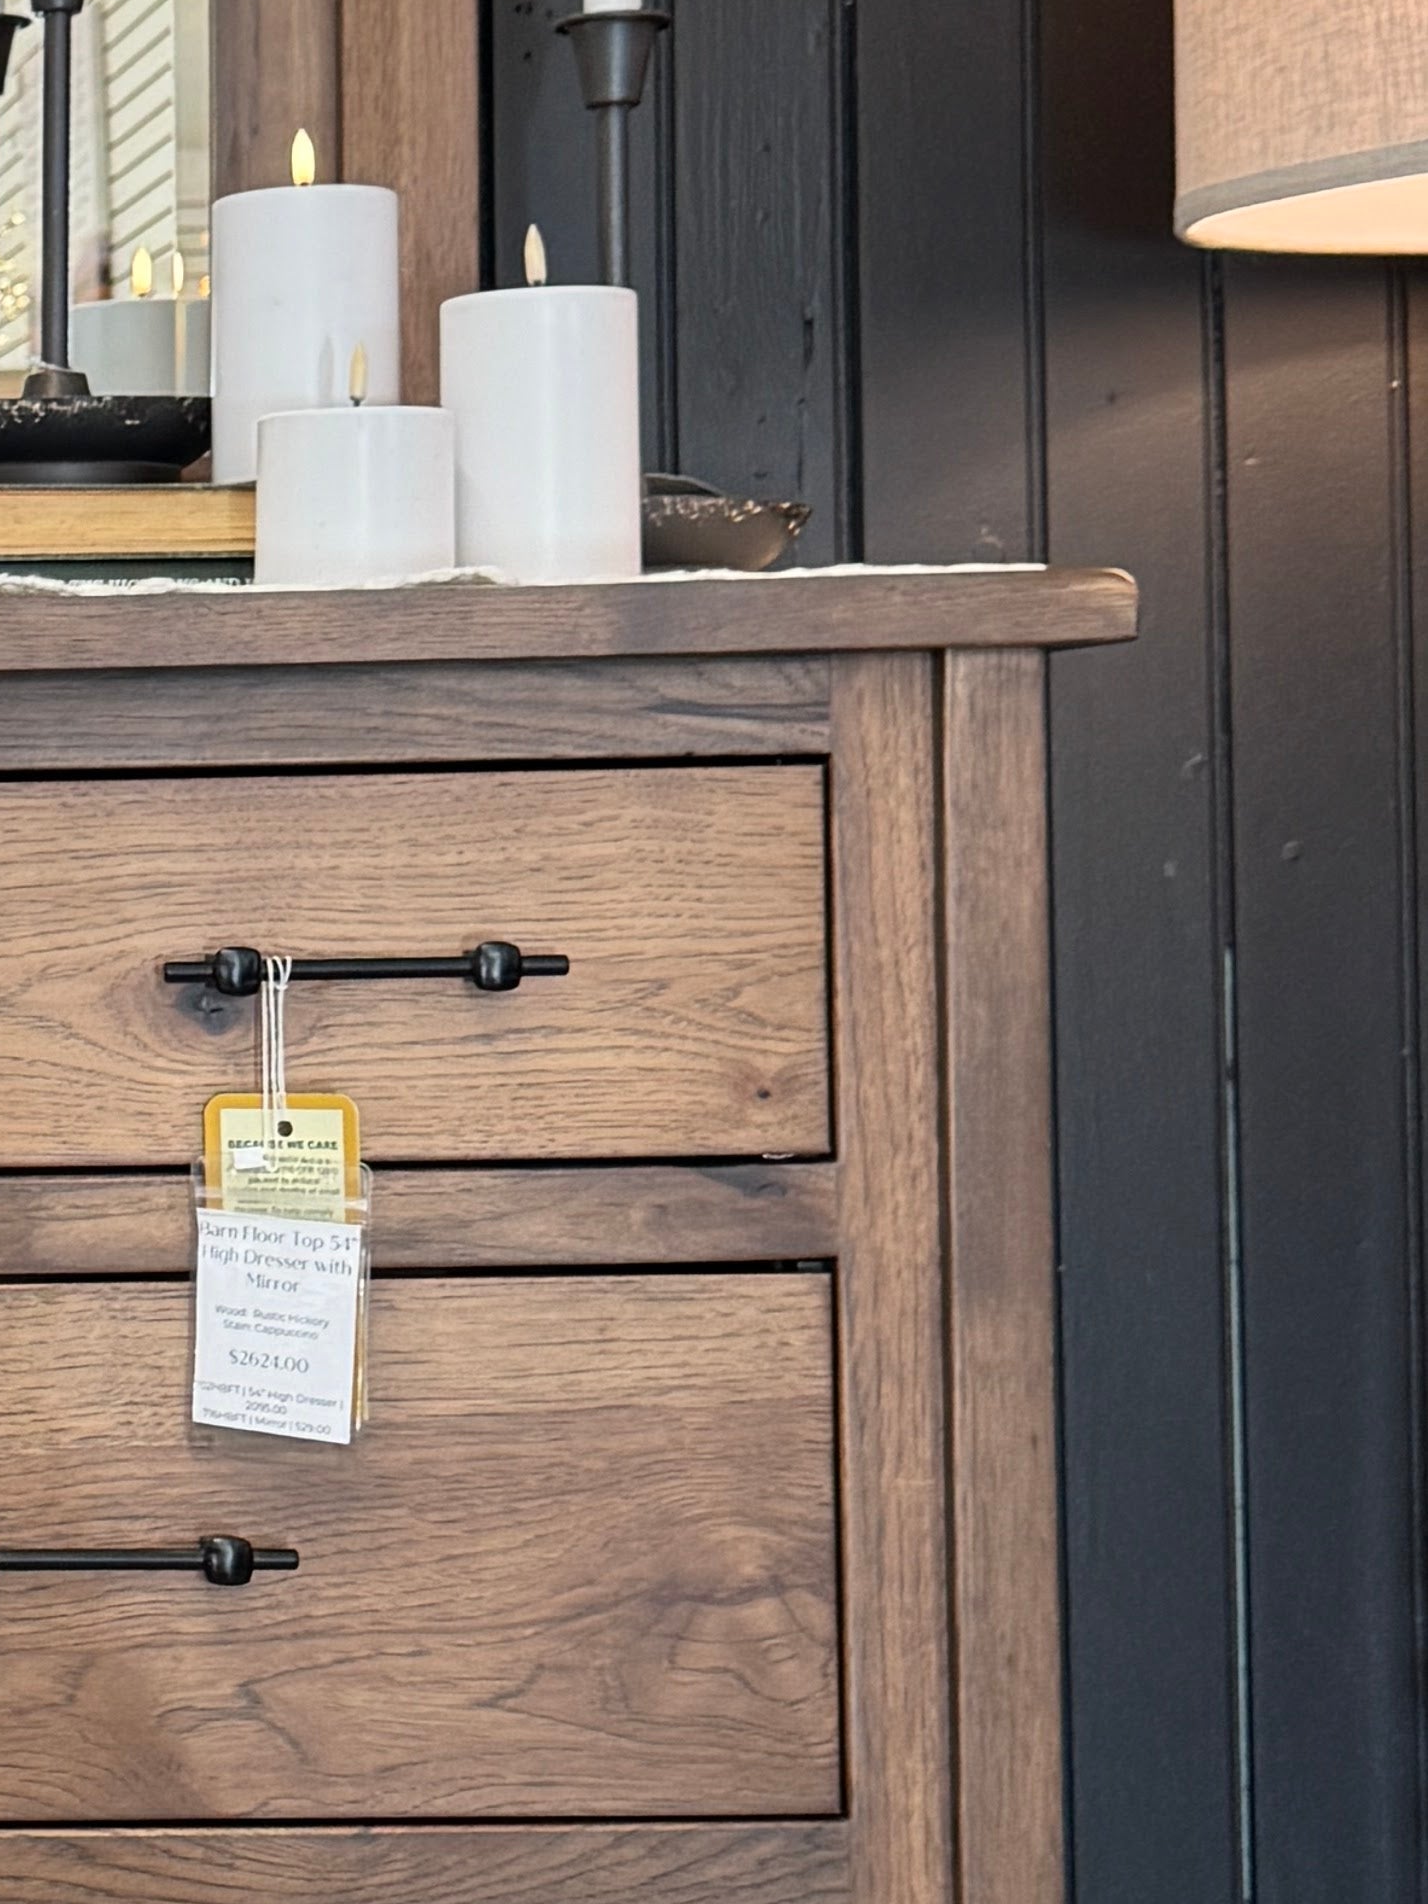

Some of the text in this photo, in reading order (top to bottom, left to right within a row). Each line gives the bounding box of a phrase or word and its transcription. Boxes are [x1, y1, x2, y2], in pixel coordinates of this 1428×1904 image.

[228, 1139, 339, 1151] BECASE WE CARE
[200, 1220, 239, 1240] Barn
[242, 1225, 286, 1245] Floor
[293, 1230, 324, 1252] Top
[201, 1244, 352, 1277] High Dresser with
[246, 1271, 302, 1293] Mirror
